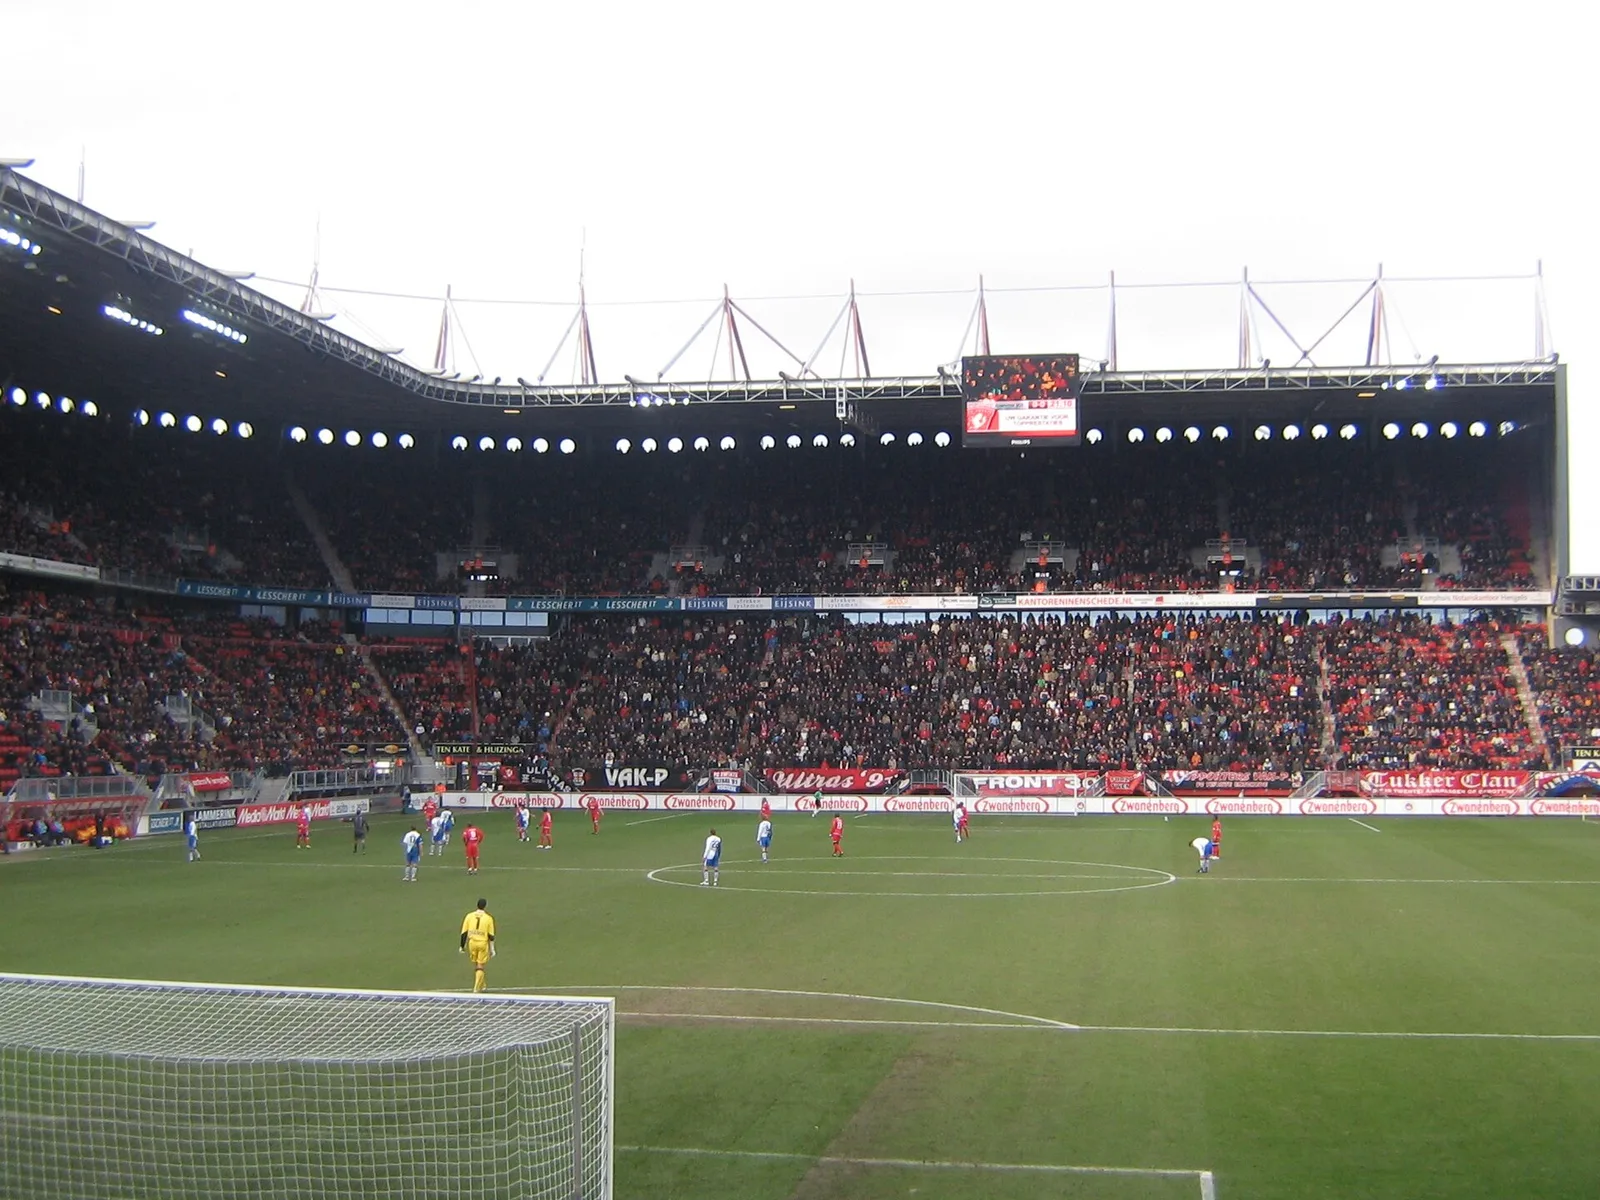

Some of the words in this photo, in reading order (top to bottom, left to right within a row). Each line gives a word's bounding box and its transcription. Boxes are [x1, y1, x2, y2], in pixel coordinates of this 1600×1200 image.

[197, 585, 231, 596] LESSCHER
[256, 591, 299, 601] LESSCHER
[530, 601, 574, 610] LESSCHER
[606, 601, 649, 609] LESSCHER
[1018, 596, 1134, 606] KANTORENINENSCHEDE.NL
[437, 745, 451, 754] TEN
[452, 745, 470, 754] KATE
[476, 745, 483, 754] &
[1575, 749, 1591, 757] TEN
[605, 768, 669, 788] VAK-P
[772, 771, 854, 788] Ultras
[973, 775, 1058, 790] FRONT
[1365, 771, 1455, 789] Tukker
[1460, 772, 1517, 789] Clan
[587, 795, 641, 809] Zanenberg
[671, 796, 728, 810] Zwanenberg
[802, 797, 860, 811] Zwnenberg
[892, 798, 949, 812] Zwanenberg
[982, 799, 1041, 812] Zwanenberg
[1119, 799, 1180, 813] Zwanenberg
[1213, 799, 1273, 813] Zwanenberg
[1307, 799, 1368, 813] Zwanenberg
[1450, 799, 1511, 814] Zwanenberg
[194, 808, 237, 821] LAMMERINK
[475, 916, 481, 930] 1
